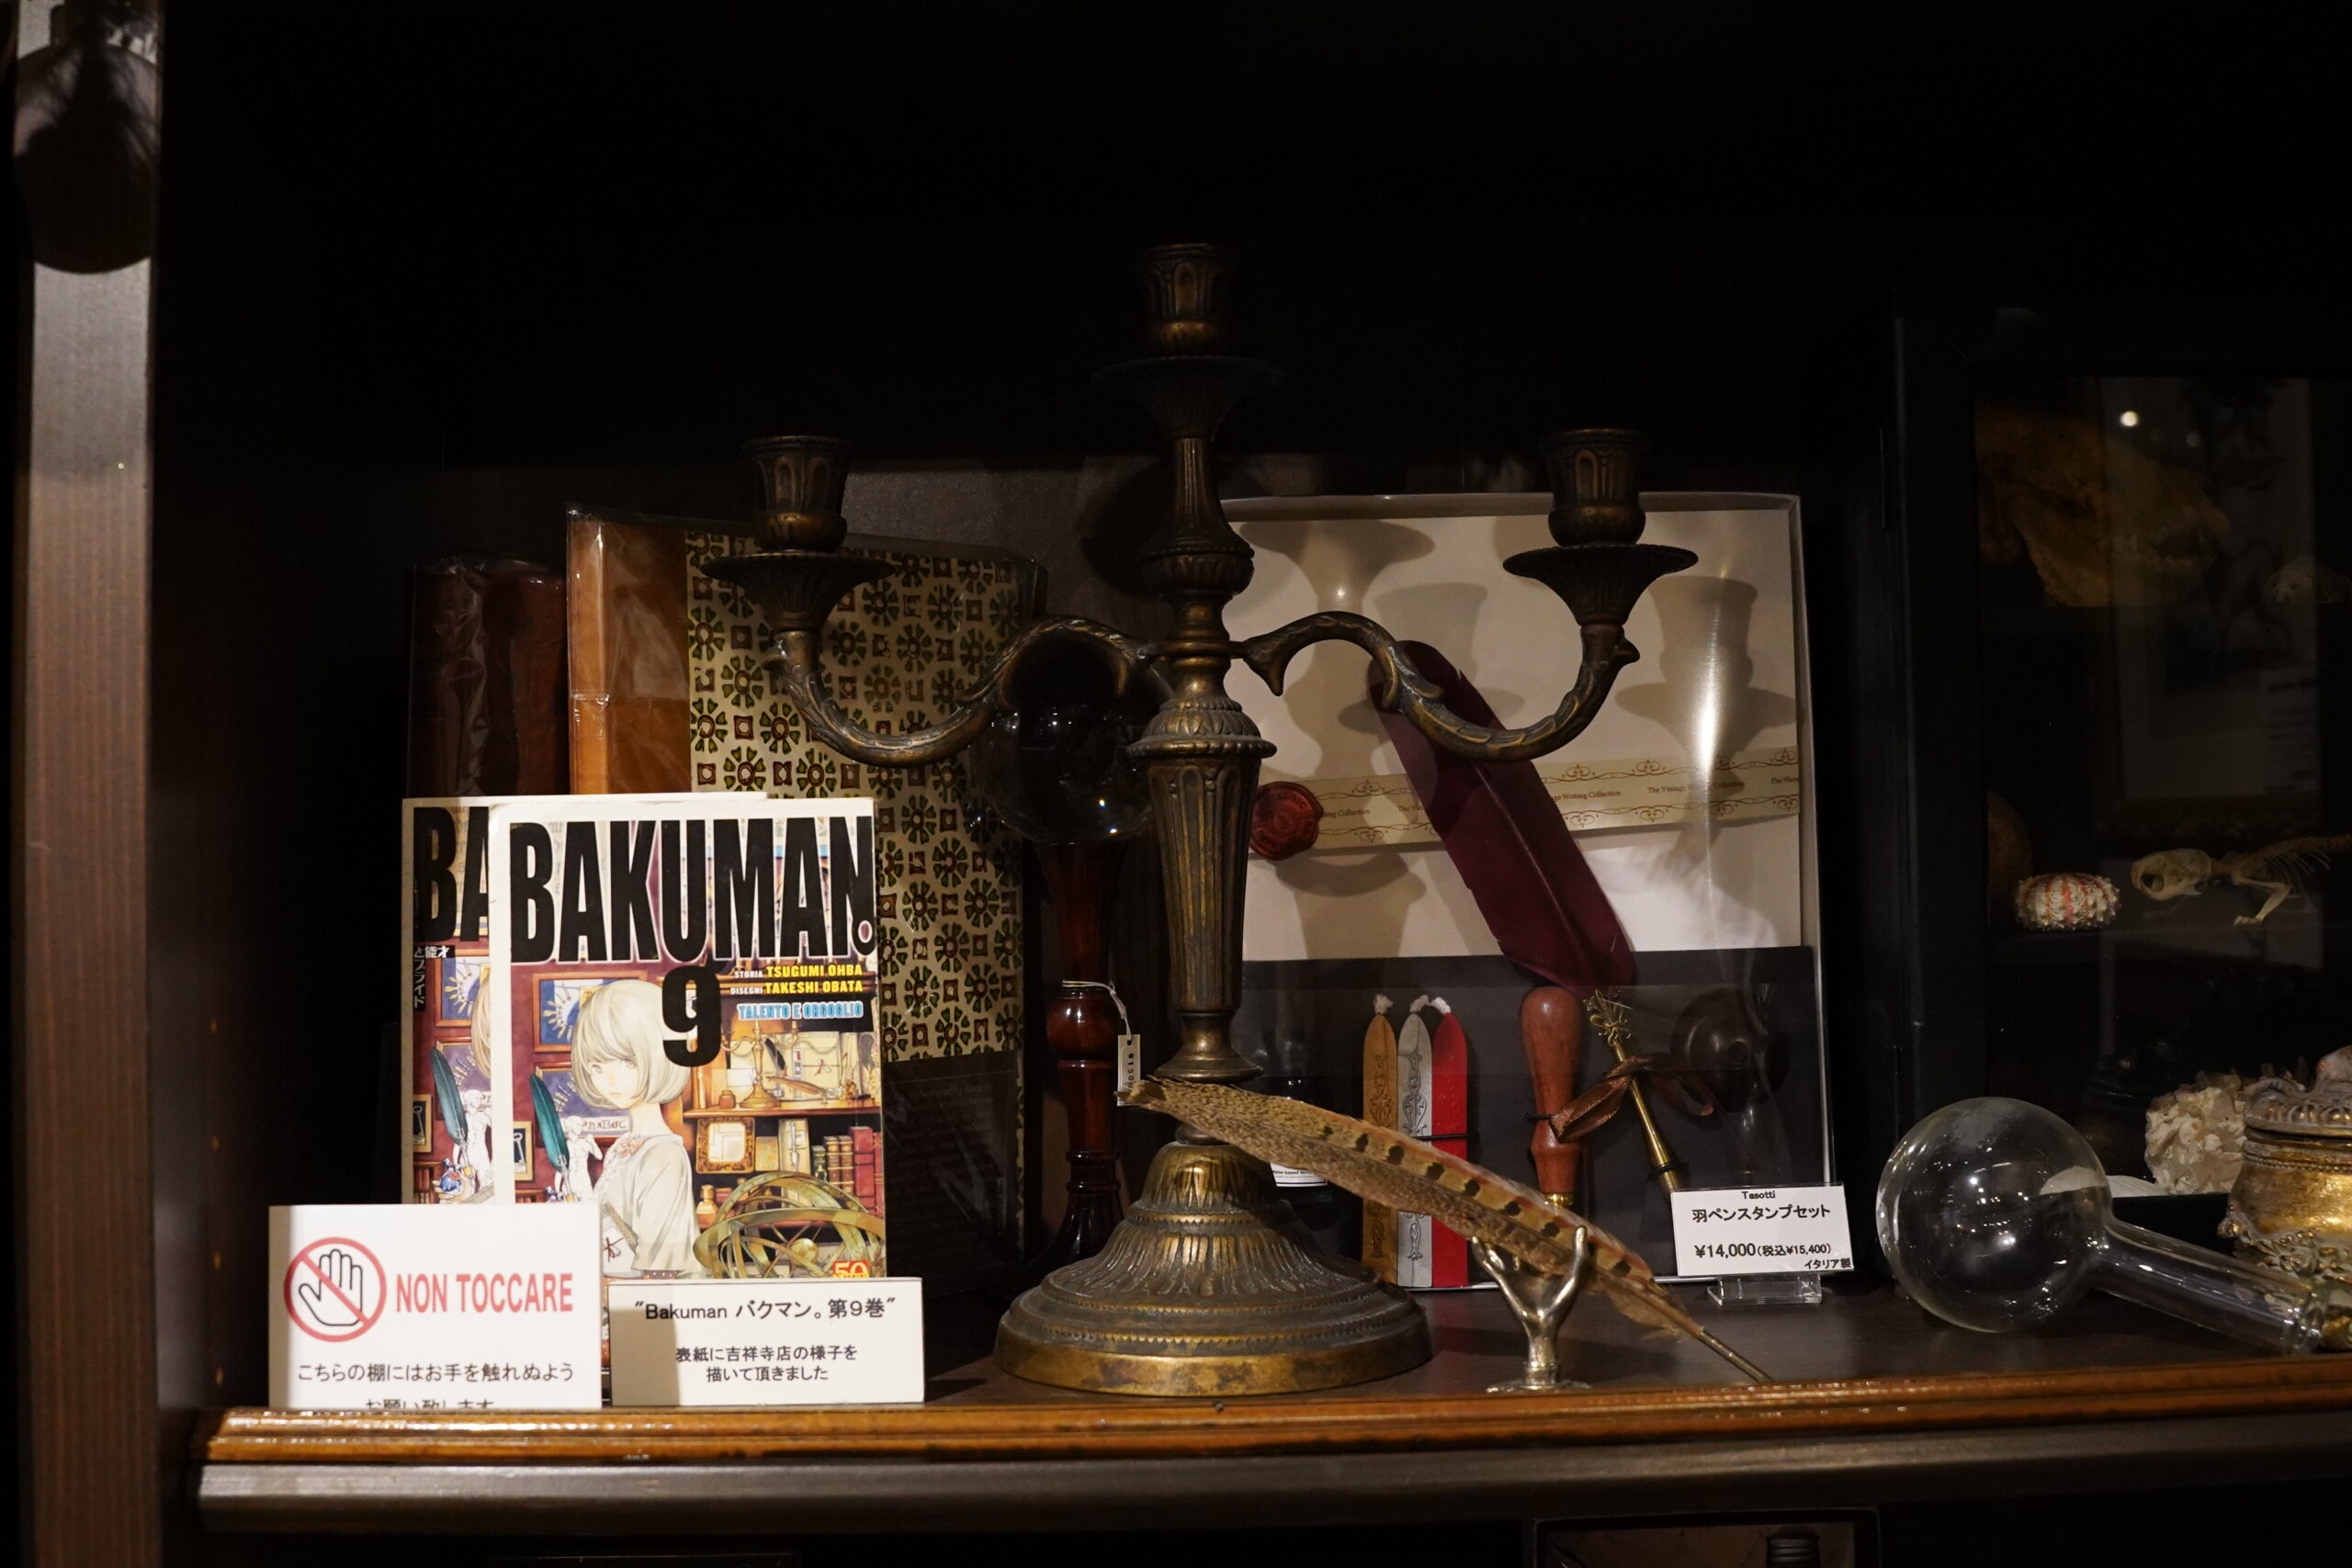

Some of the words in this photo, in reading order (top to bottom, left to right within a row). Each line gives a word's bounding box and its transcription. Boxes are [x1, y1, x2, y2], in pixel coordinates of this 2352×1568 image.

[735, 970, 763, 979] STORIA
[766, 965, 824, 978] TSUGUMI
[828, 964, 863, 976] OHBA
[730, 987, 763, 995] DISEGNI
[764, 982, 819, 995] TAKESHI
[822, 980, 864, 993] OBATA
[662, 964, 721, 1066] 9
[737, 1003, 790, 1020] TALENTO
[791, 1002, 802, 1019] E
[802, 1001, 864, 1019] ORGOGLIO
[1742, 1190, 1776, 1200] Tasotti
[1691, 1204, 1830, 1223] 羽ペンスタンプセット
[1804, 1258, 1851, 1269] イタリア製
[396, 1273, 447, 1313] NON
[456, 1272, 573, 1313] TOCCARE
[675, 1345, 858, 1362] 表紙に吉祥寺店の様子を
[298, 1363, 574, 1382] こちらの棚にはお手を触れぬよう
[706, 1366, 830, 1382] 描いて頂きました
